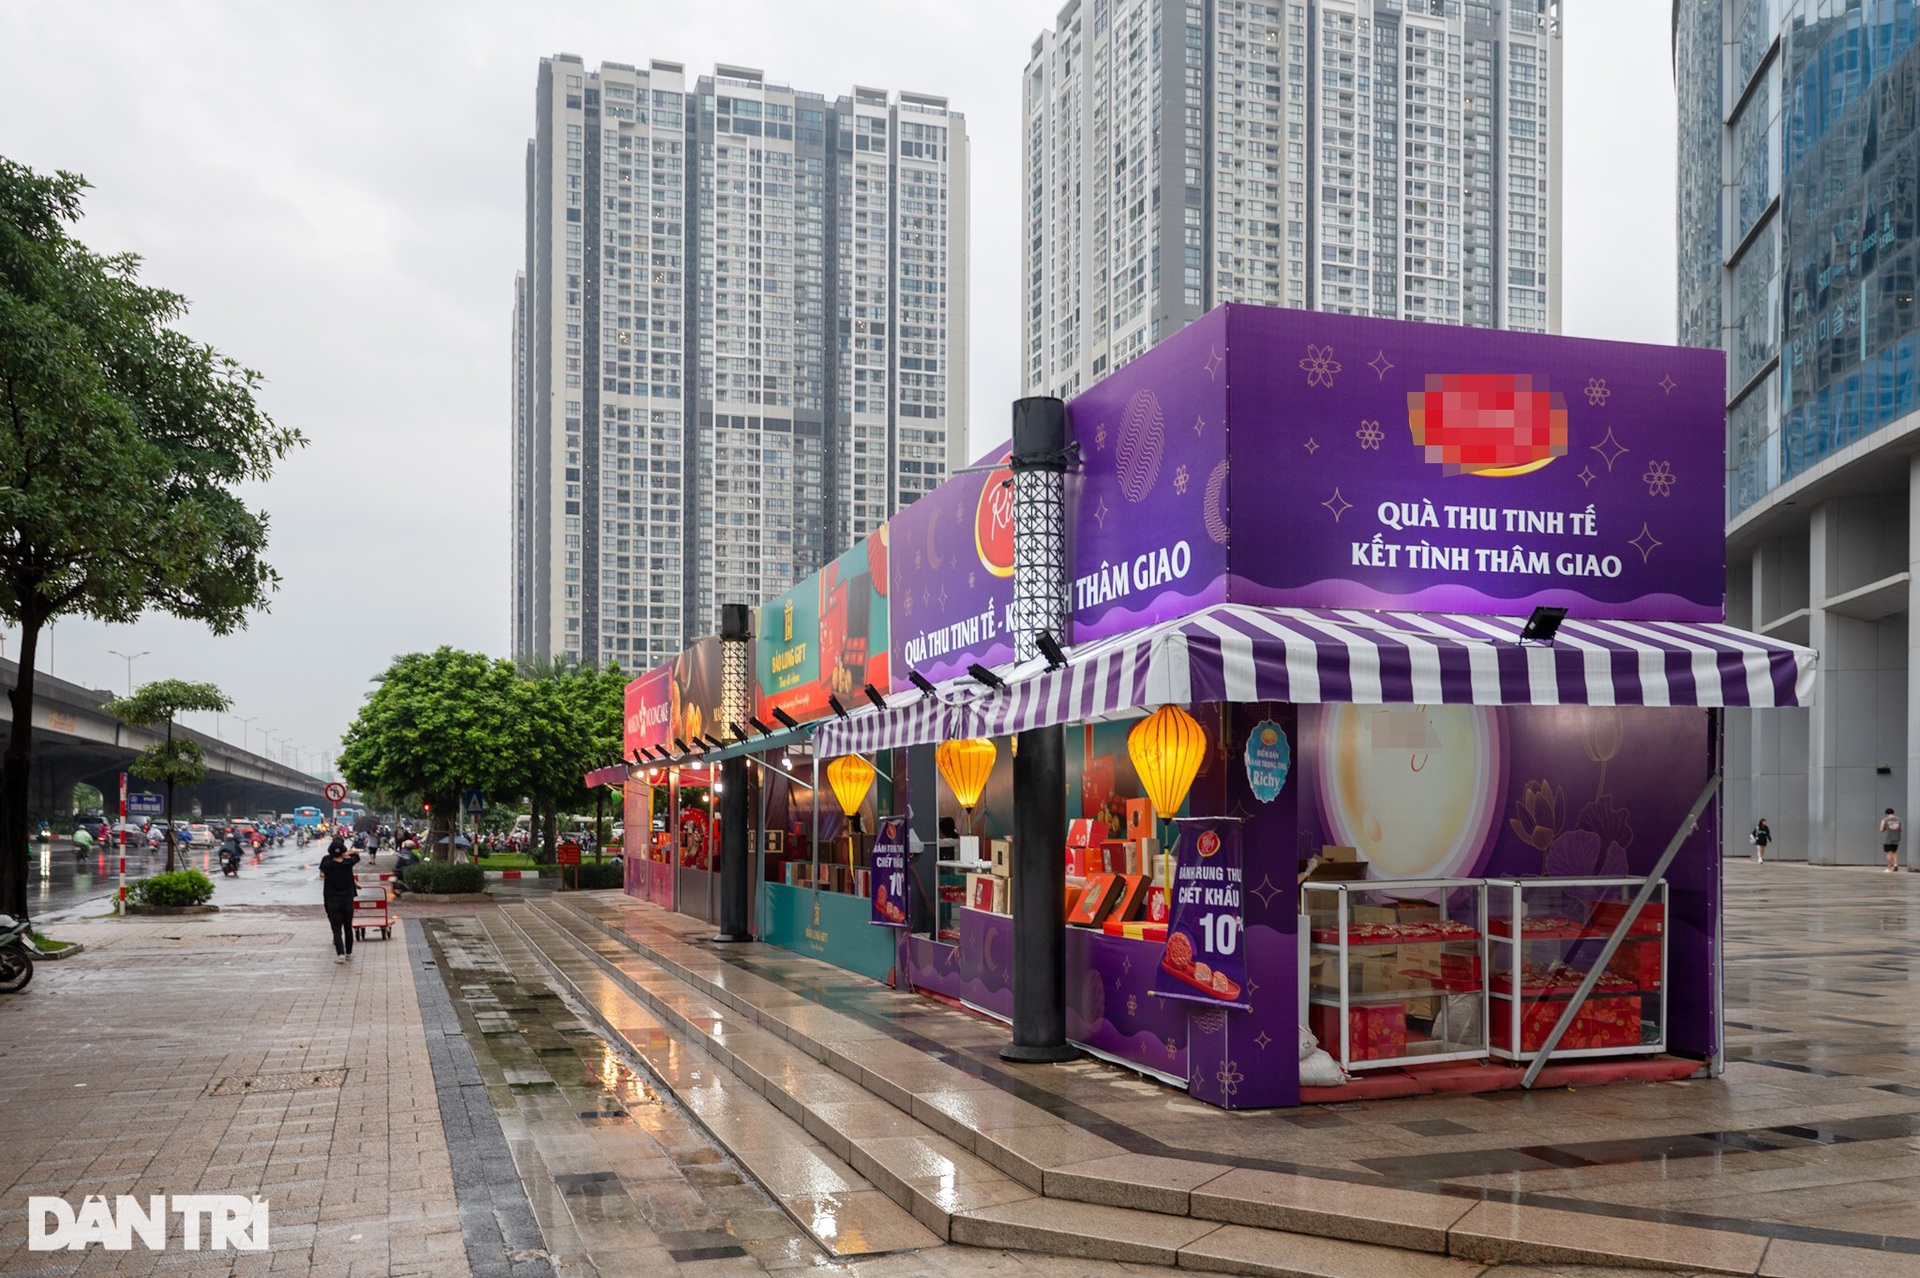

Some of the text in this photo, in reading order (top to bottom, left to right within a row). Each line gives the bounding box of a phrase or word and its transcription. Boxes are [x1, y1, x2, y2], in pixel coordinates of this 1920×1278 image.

[1377, 498, 1598, 536] QUÀ THU TINH TẾ
[1351, 533, 1622, 578] KẾT TÌNH THÂM GIAO
[904, 630, 928, 669] QUÀ
[928, 625, 949, 658] THU
[951, 615, 979, 651] TINH
[980, 596, 996, 641] TẾ
[1076, 560, 1130, 611] THÂM
[1133, 540, 1191, 591] GIAO
[1253, 770, 1280, 791] Richy
[1205, 883, 1240, 908] KHẤU
